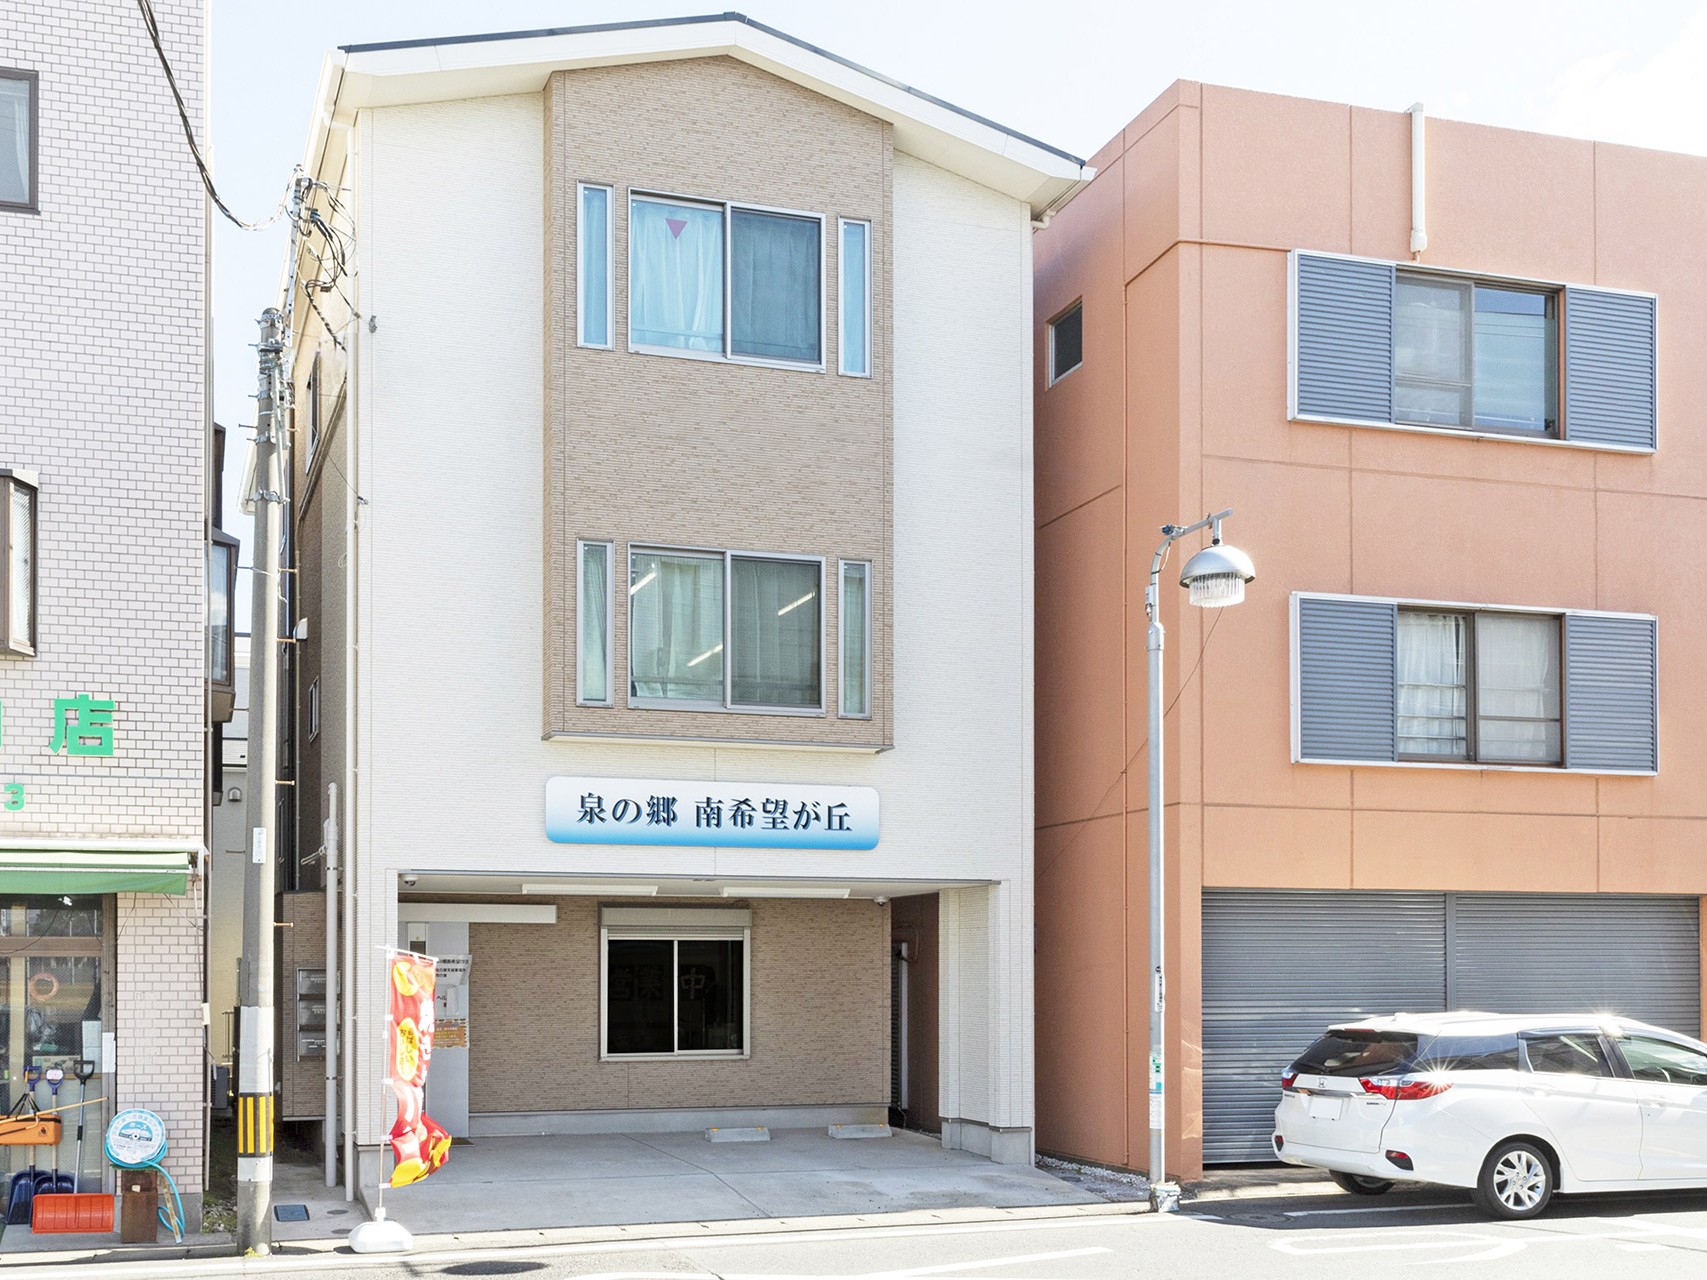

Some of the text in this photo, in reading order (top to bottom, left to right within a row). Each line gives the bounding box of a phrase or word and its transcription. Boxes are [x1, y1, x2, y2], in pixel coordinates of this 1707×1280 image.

[0, 693, 116, 757] 店
[4, 783, 26, 811] 3
[577, 791, 853, 832] 泉の郷 南希望が丘
